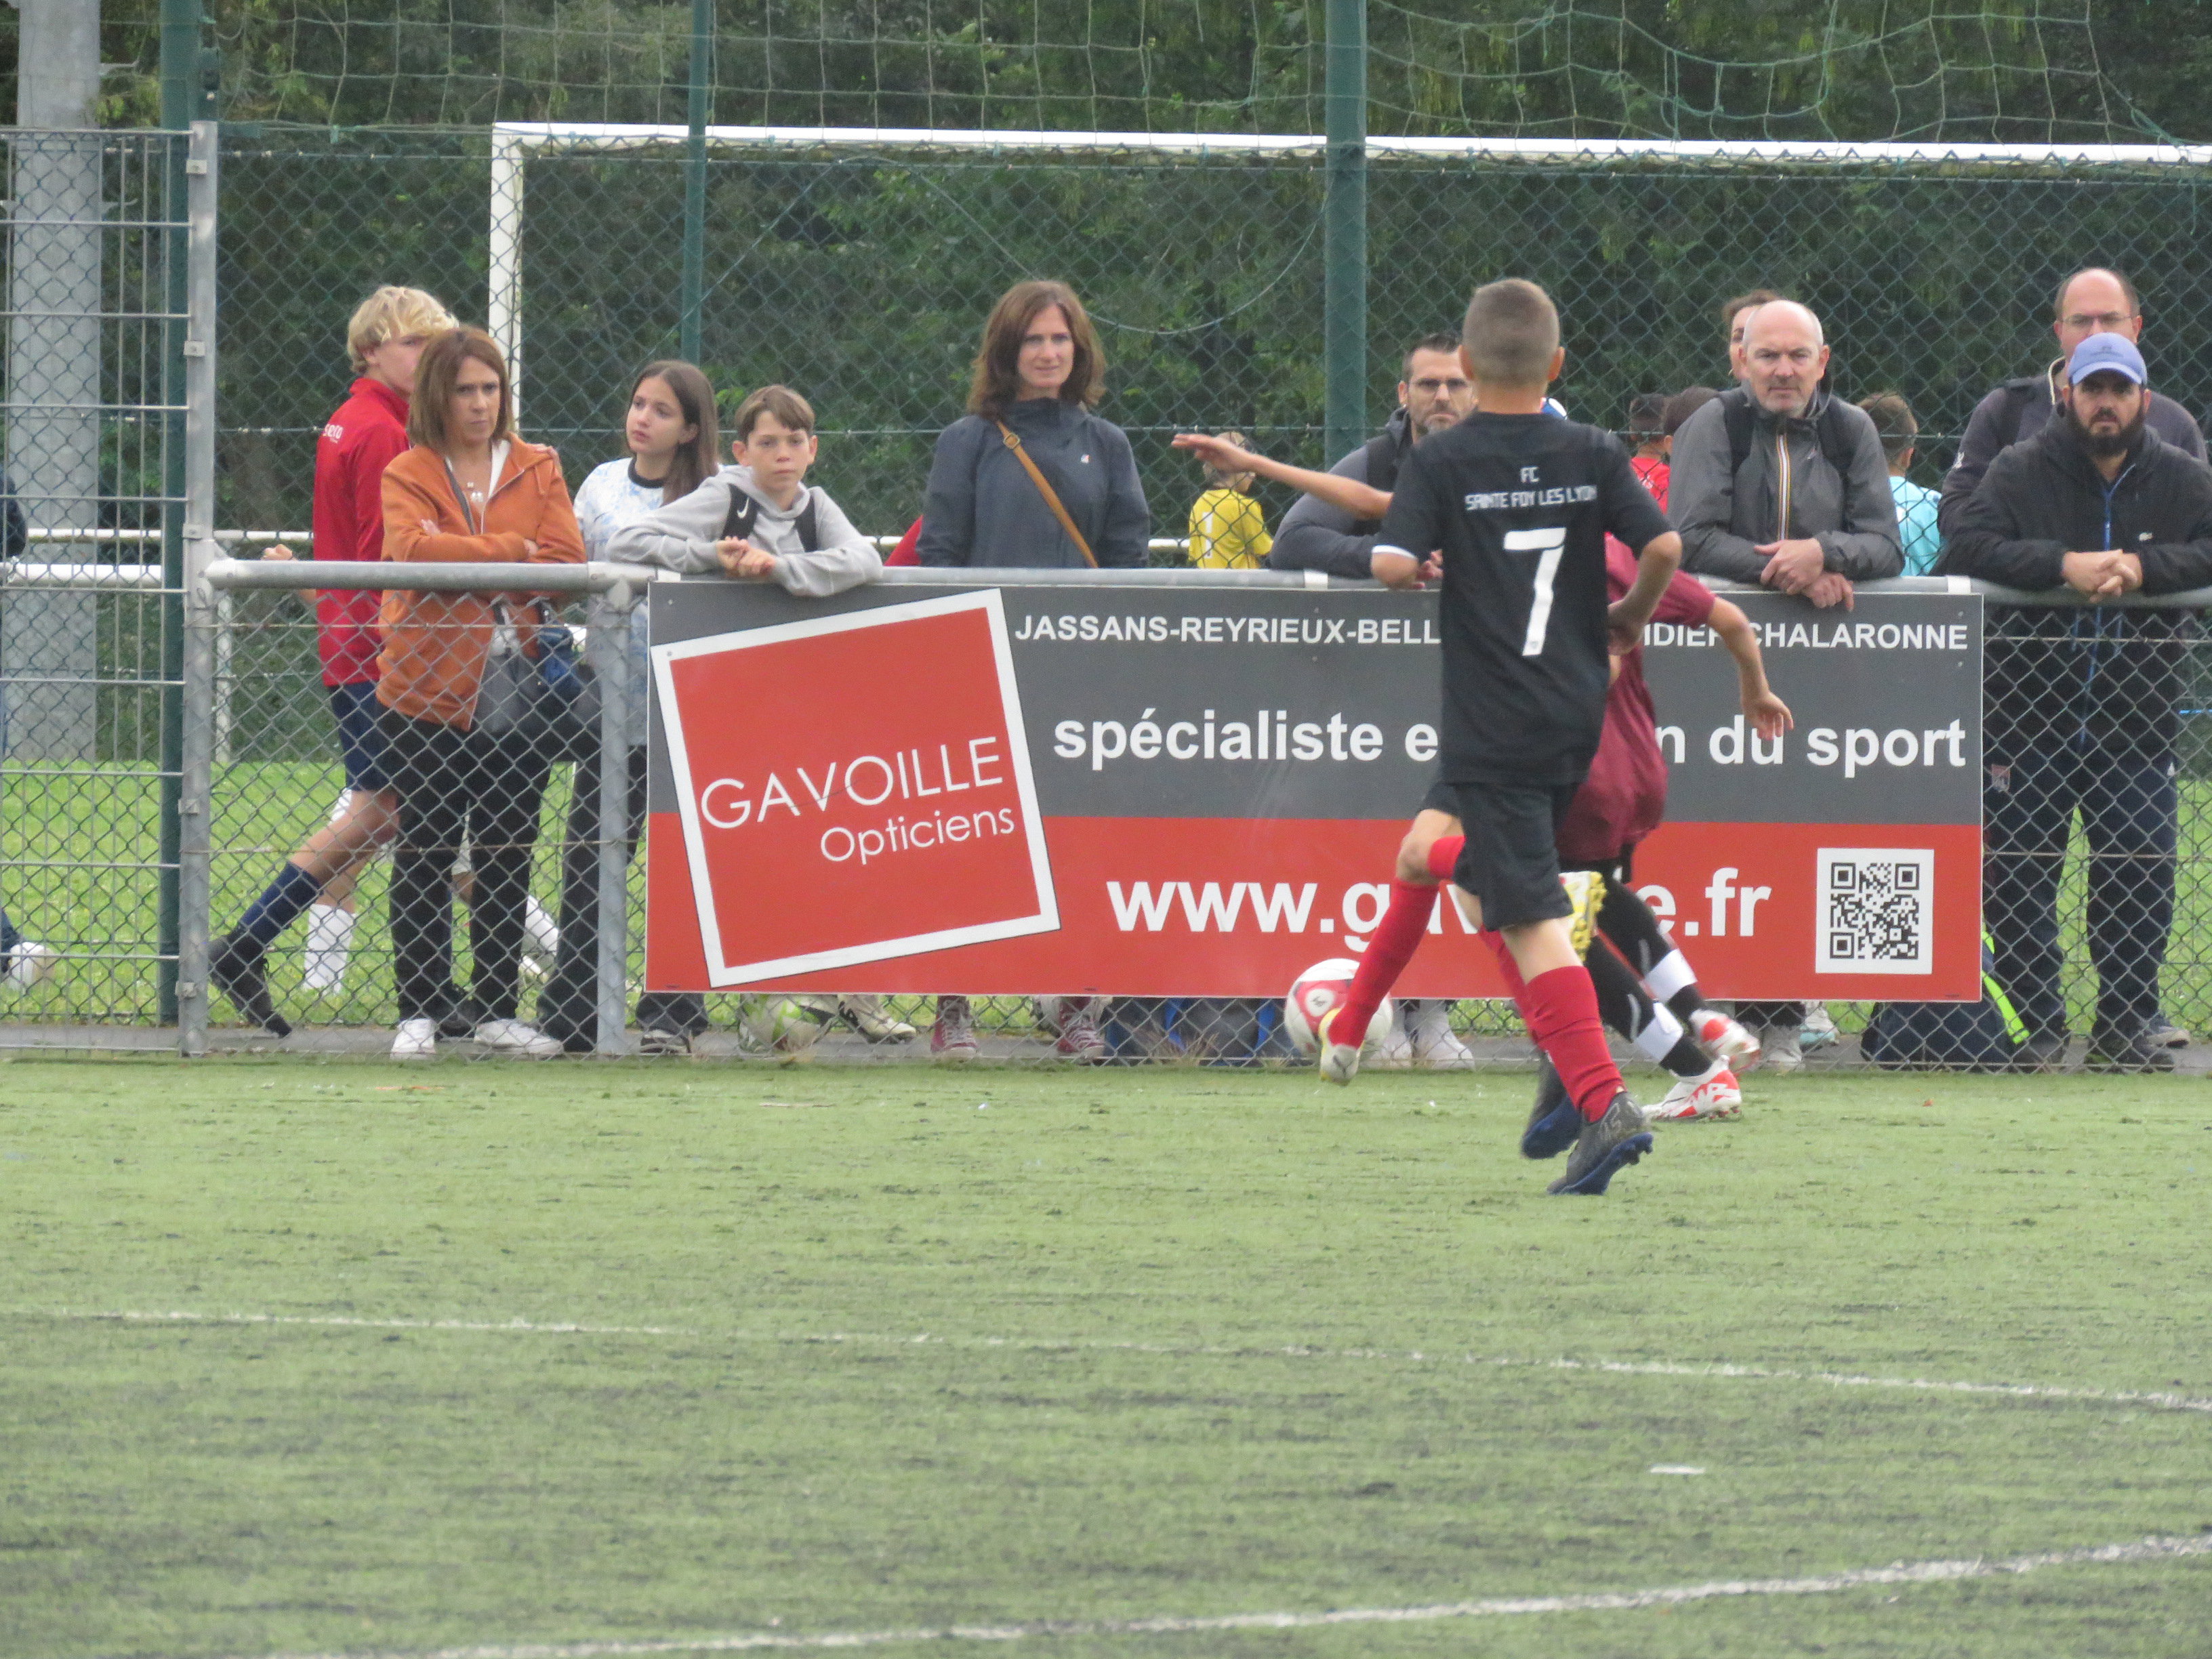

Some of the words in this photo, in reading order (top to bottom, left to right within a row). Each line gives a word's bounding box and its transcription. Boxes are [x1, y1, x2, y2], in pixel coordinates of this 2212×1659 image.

[1538, 487, 1565, 506] LES
[1504, 528, 1566, 656] 7
[1015, 615, 1441, 644] JASSANS-REYRIEUX-BELL
[1054, 708, 1384, 771] spécialiste
[1709, 714, 1784, 765] du
[1807, 719, 1967, 779] sport
[701, 737, 1003, 829] GAVOILLE
[821, 808, 1015, 865] Opticiens
